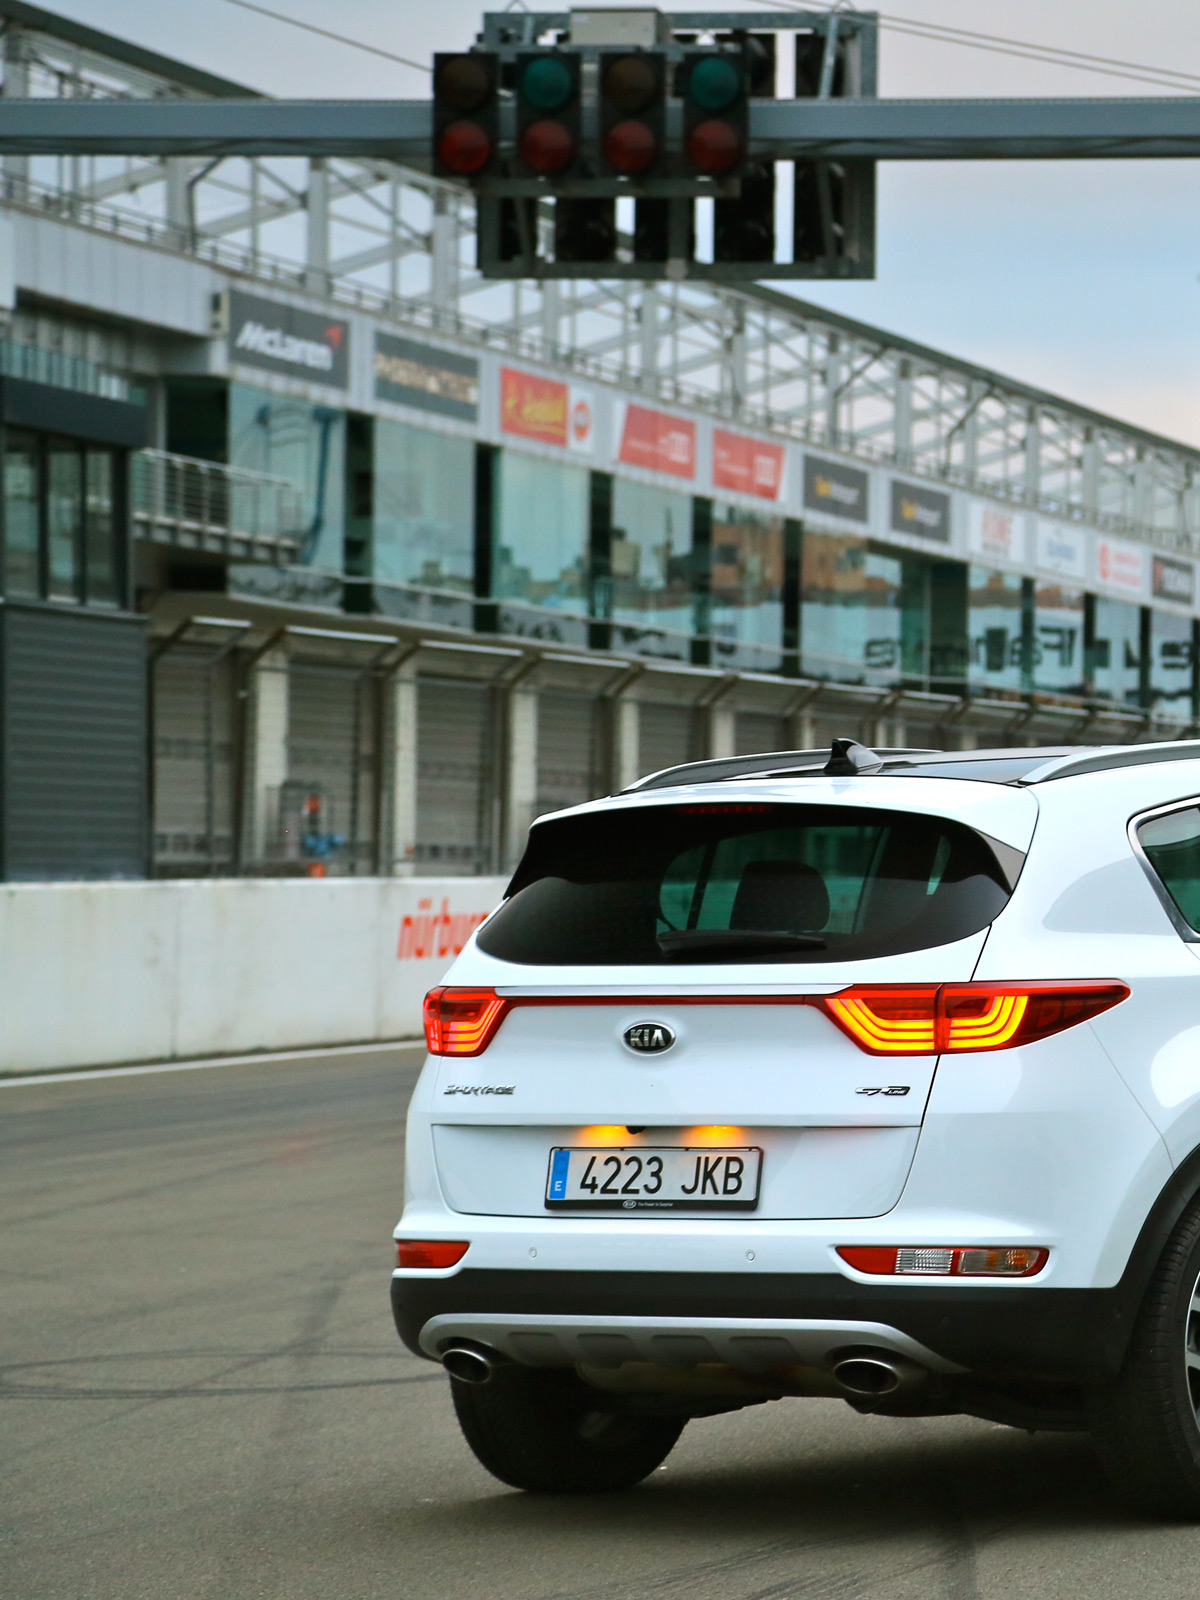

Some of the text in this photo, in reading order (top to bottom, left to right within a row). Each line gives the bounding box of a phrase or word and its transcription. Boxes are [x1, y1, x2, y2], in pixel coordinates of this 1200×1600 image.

[396, 897, 491, 959] nürbur
[630, 1029, 665, 1046] KIA
[555, 1180, 563, 1191] E
[579, 1155, 745, 1195] 4223 JKB
